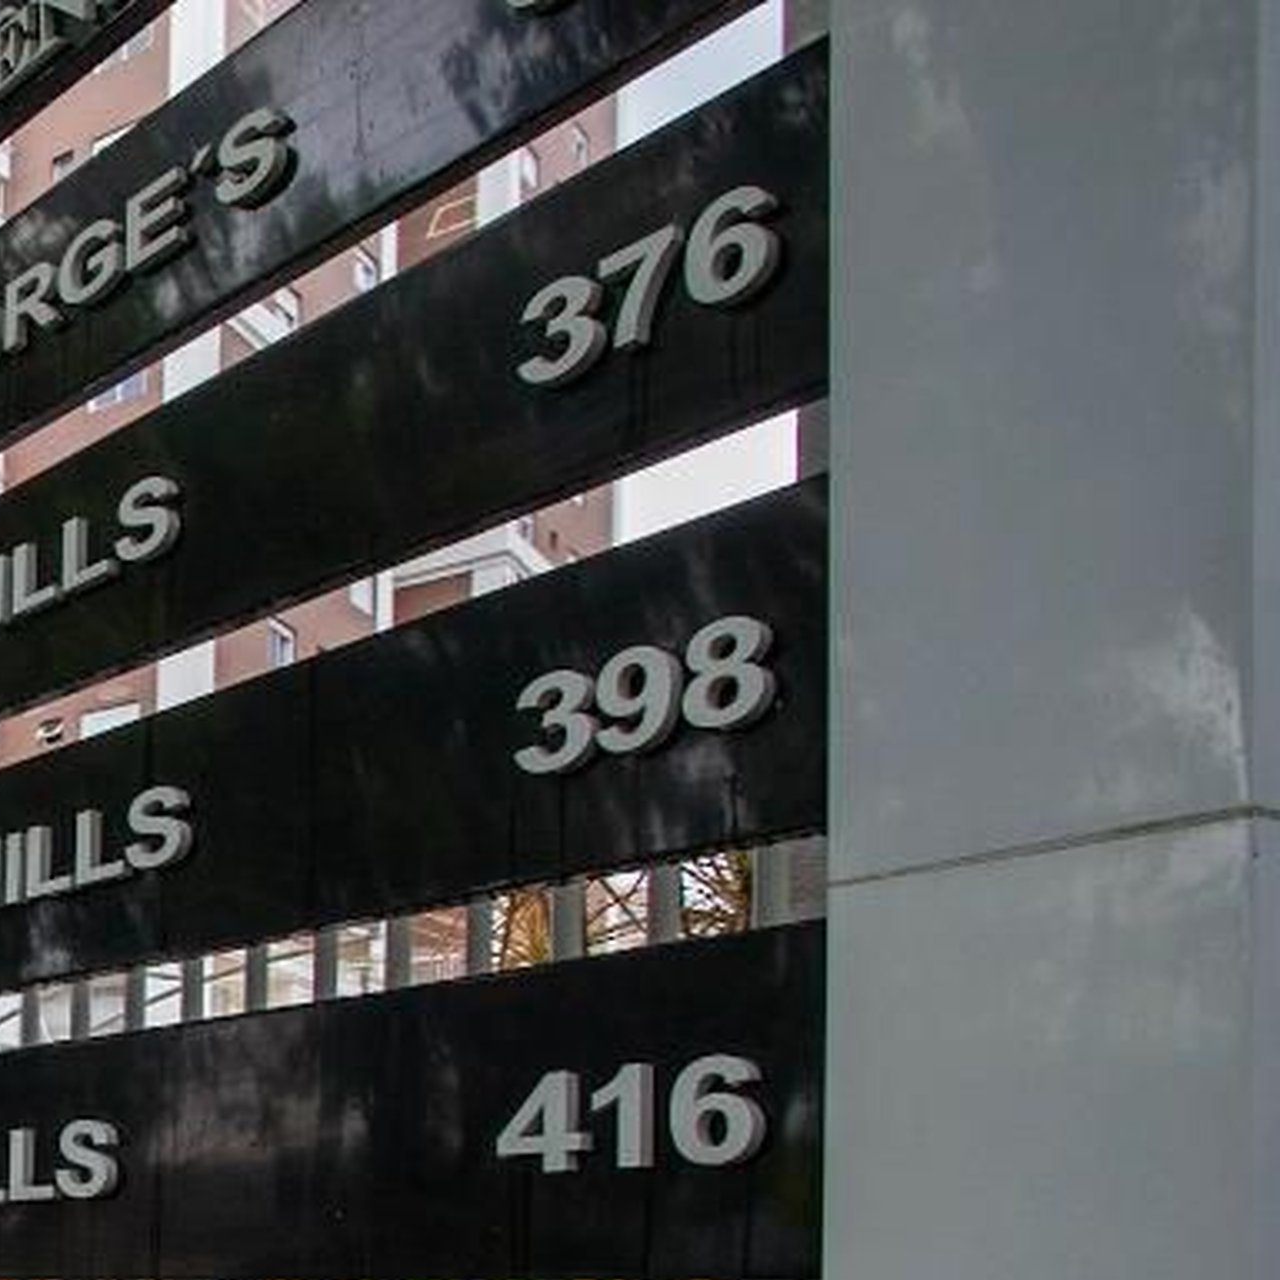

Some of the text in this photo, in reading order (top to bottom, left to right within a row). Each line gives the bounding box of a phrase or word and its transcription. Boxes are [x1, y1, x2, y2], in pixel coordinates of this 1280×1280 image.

[516, 186, 782, 385] 376
[514, 615, 776, 774] 398
[496, 1053, 766, 1173] 416
